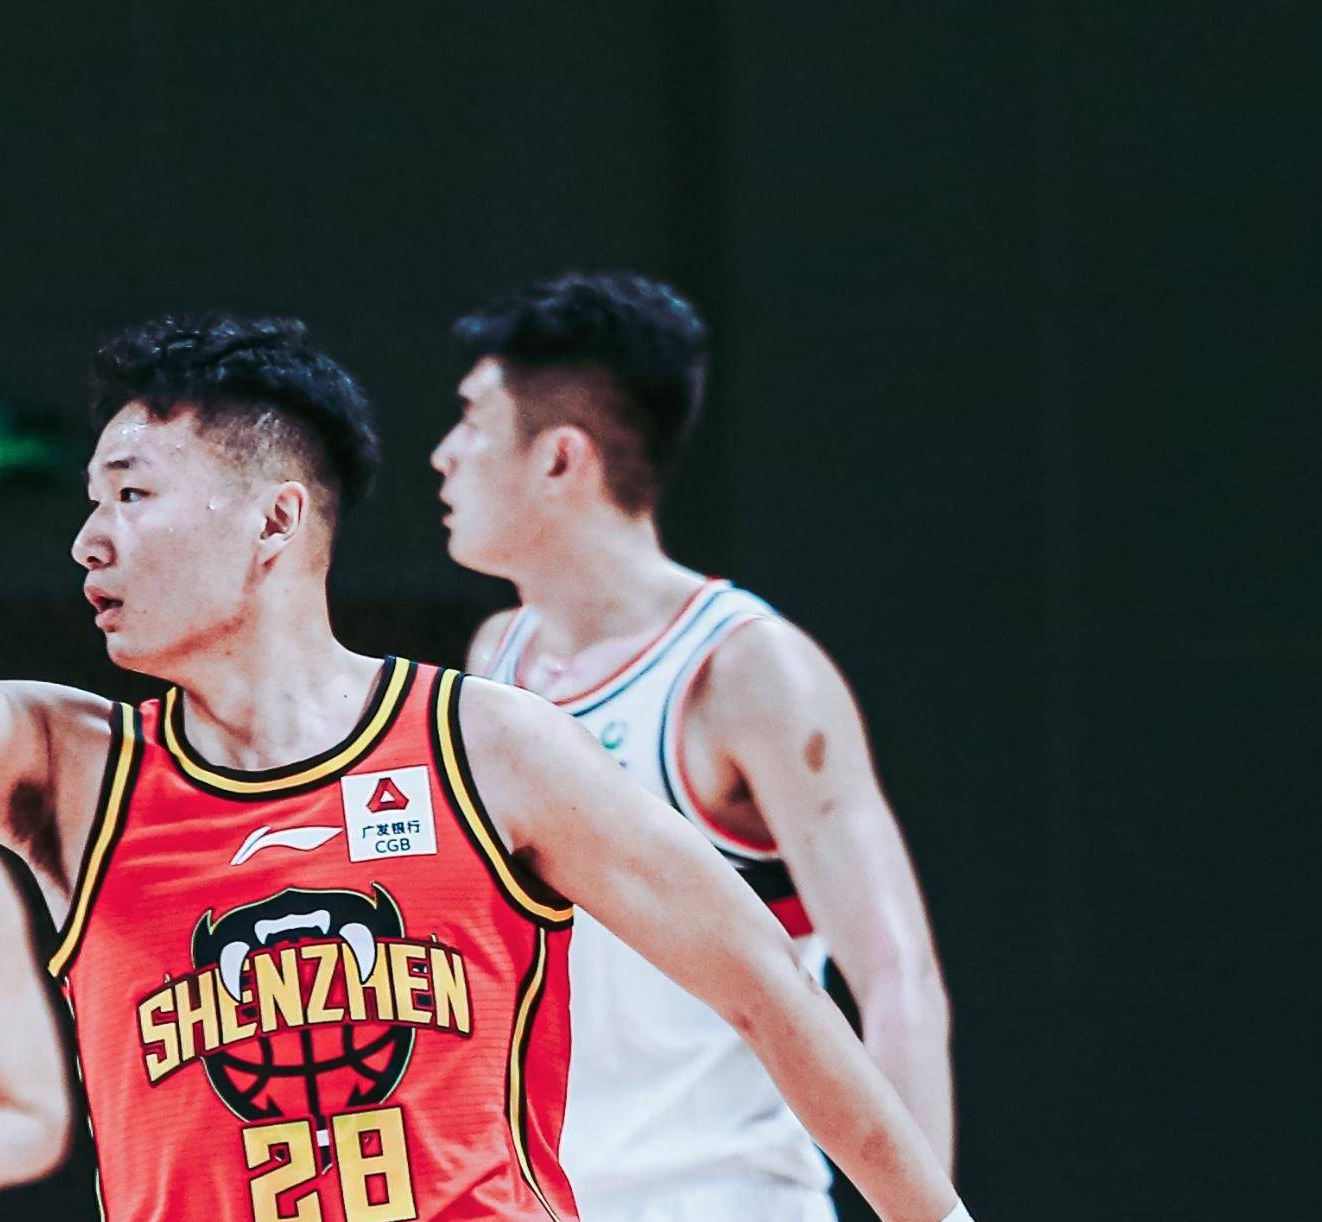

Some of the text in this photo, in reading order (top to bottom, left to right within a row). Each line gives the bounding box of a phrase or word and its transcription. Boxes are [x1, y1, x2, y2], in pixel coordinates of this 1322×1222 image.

[362, 819, 421, 839] 广发银行
[375, 838, 411, 854] CGB
[138, 942, 473, 1083] SHENZHEN
